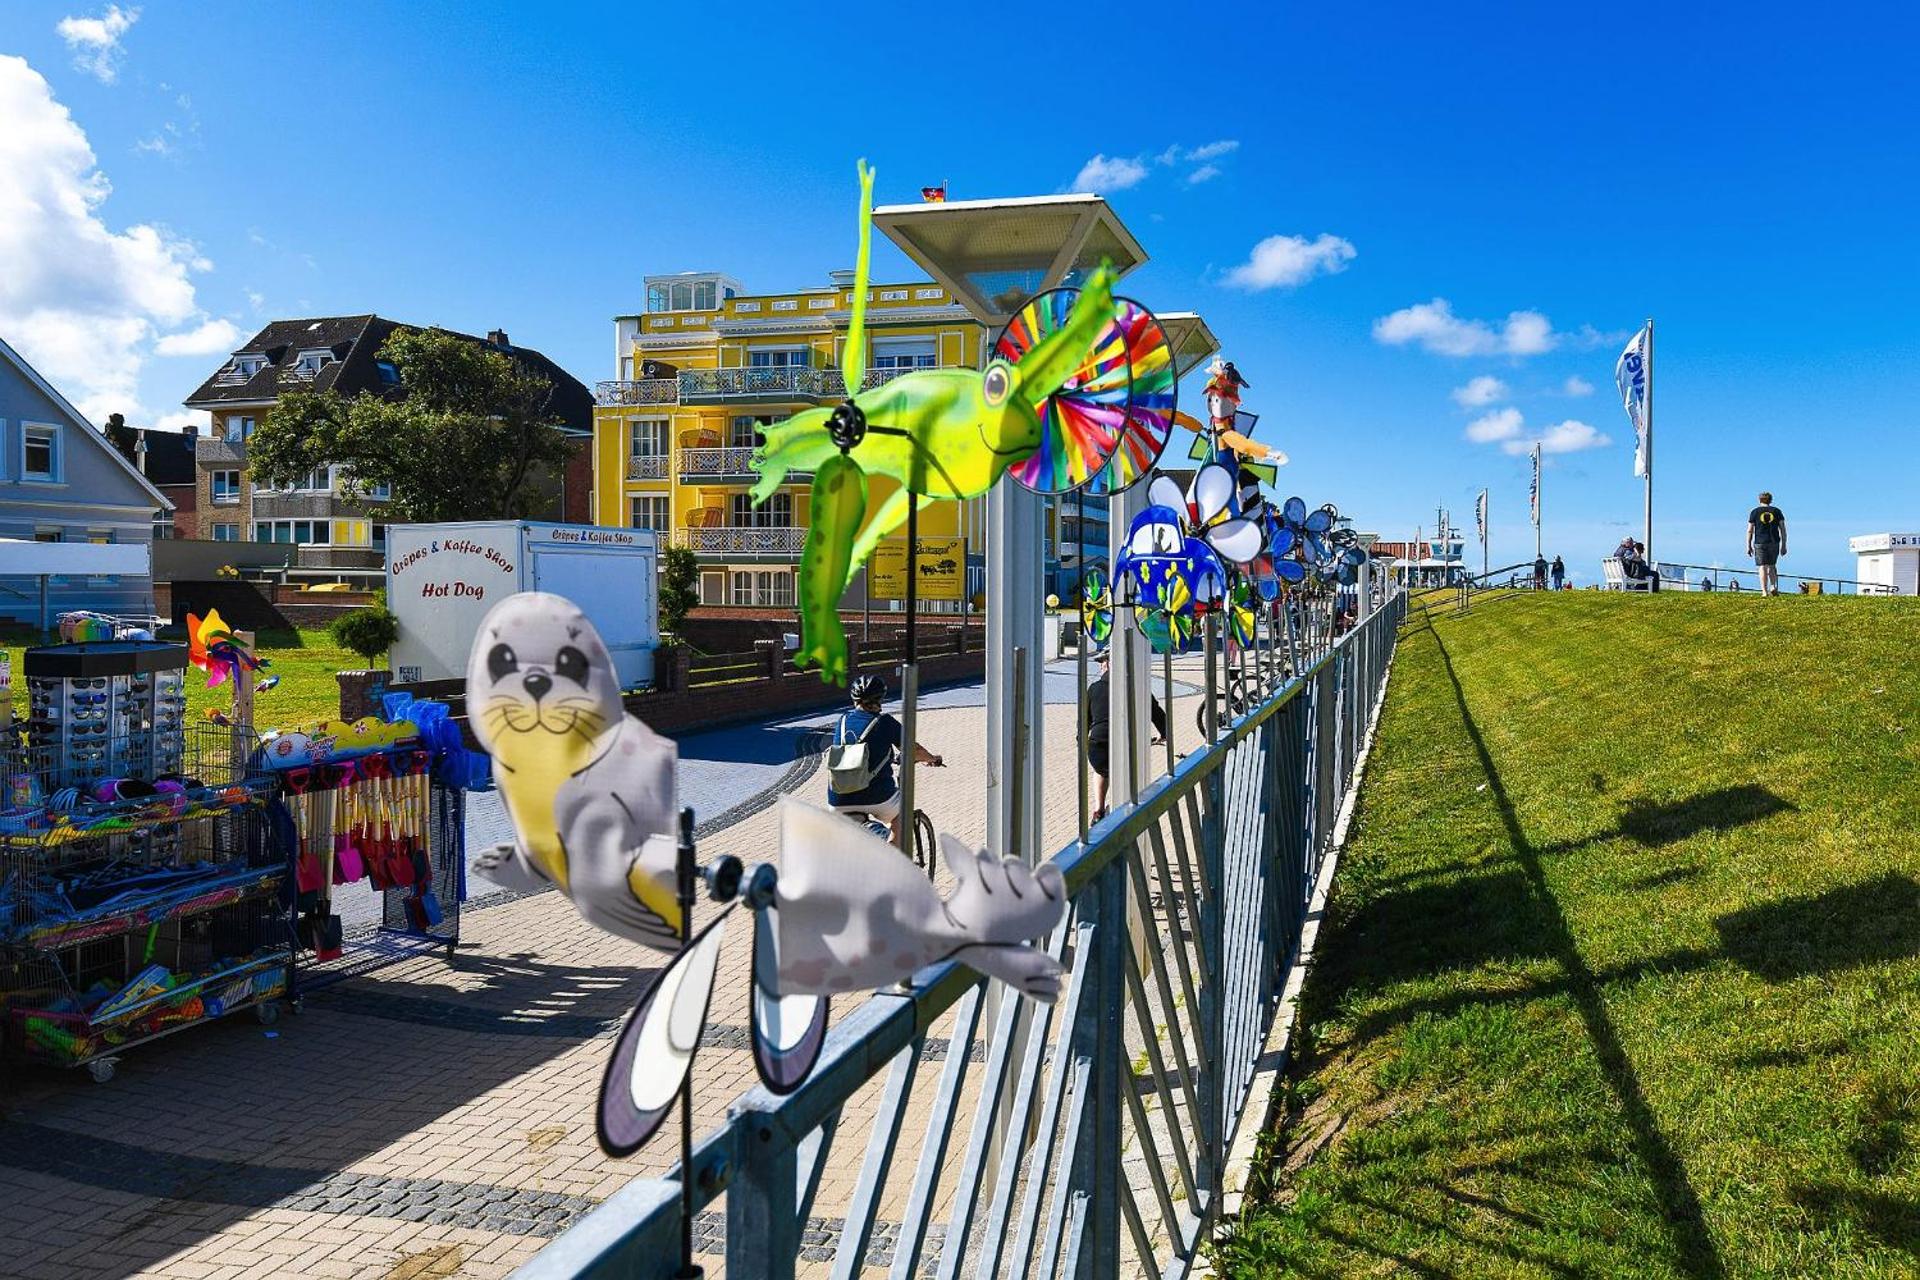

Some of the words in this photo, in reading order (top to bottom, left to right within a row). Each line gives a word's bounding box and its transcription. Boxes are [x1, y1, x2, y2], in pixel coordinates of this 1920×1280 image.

[581, 530, 587, 541] &
[588, 531, 612, 544] Kaffee
[615, 532, 633, 544] Shop
[431, 540, 439, 553] &
[444, 539, 482, 555] Kaffee
[484, 547, 514, 573] Shop
[422, 583, 449, 597] Hot
[454, 582, 484, 600] Dog
